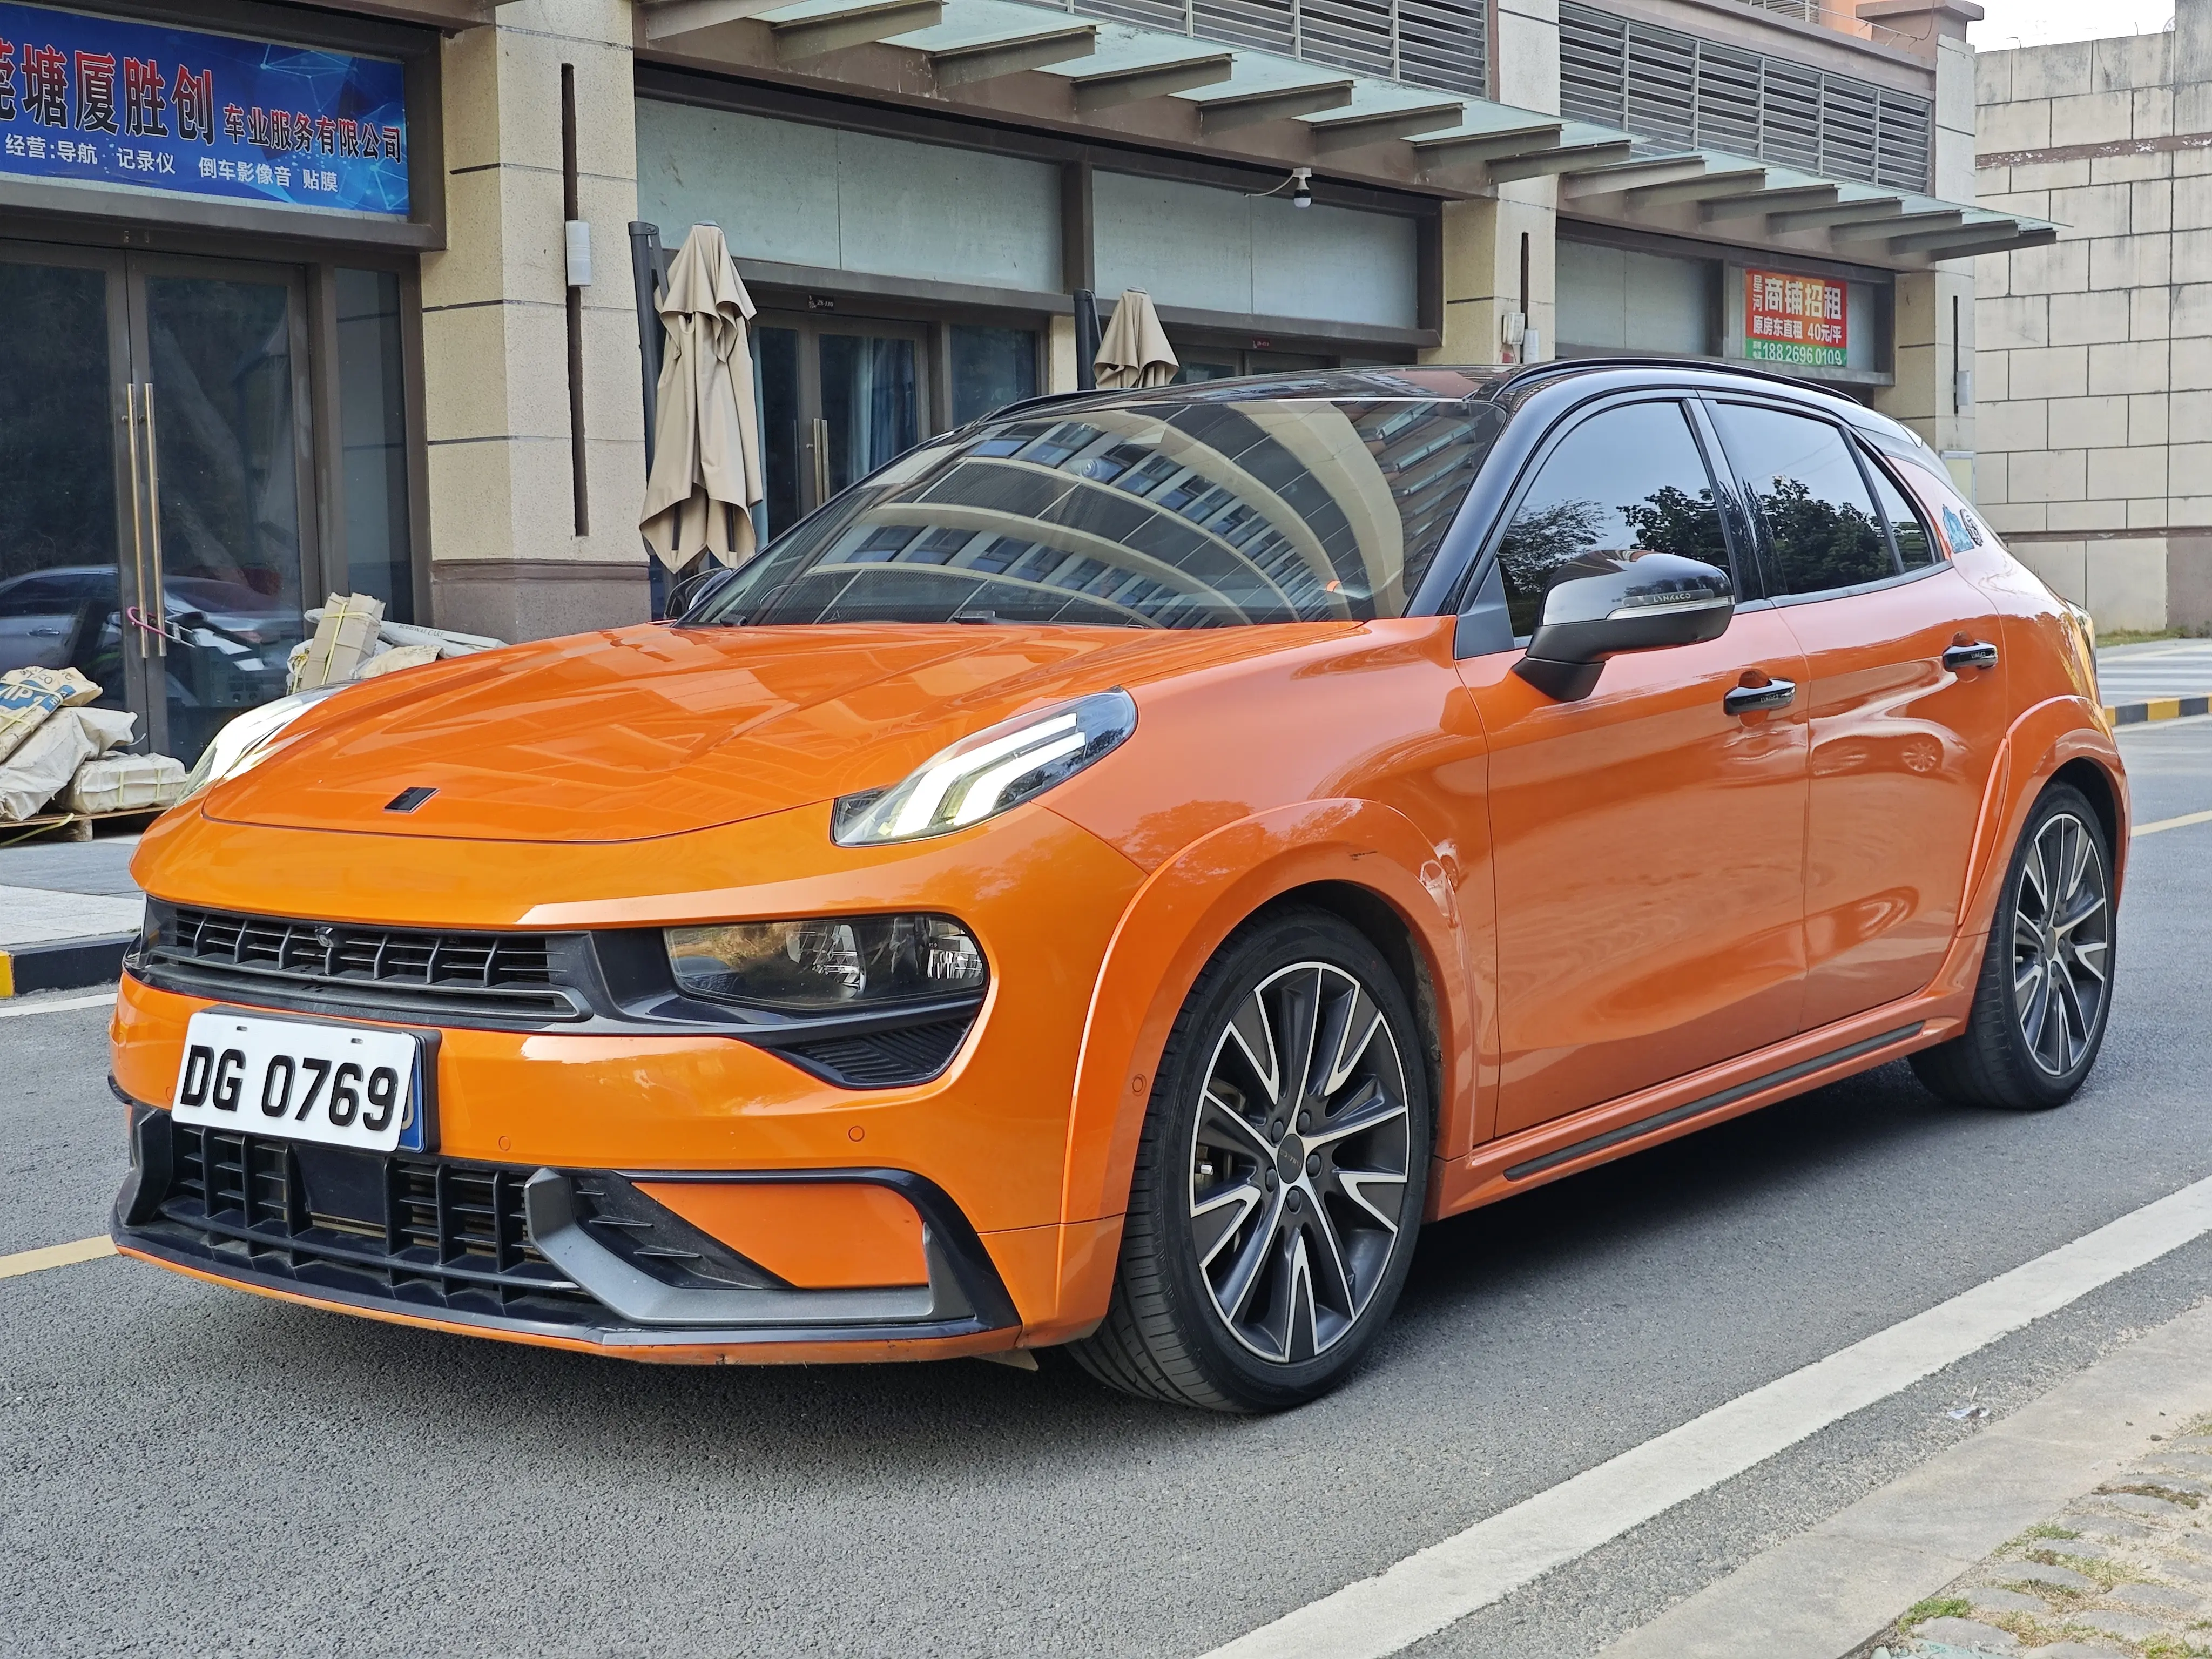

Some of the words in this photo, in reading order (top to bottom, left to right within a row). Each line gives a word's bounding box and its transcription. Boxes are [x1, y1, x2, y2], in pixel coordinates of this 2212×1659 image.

[223, 102, 402, 164] 车业服务有限公司
[116, 147, 176, 174] 记录仪
[198, 156, 292, 187] 倒车影像音
[302, 169, 338, 193] 贴膜
[1764, 277, 1842, 320] 商铺招租
[1753, 315, 1803, 340] 原房东直租
[1807, 322, 1842, 344] 40元/平
[180, 1044, 247, 1112] DG
[261, 1054, 400, 1132] 0769
